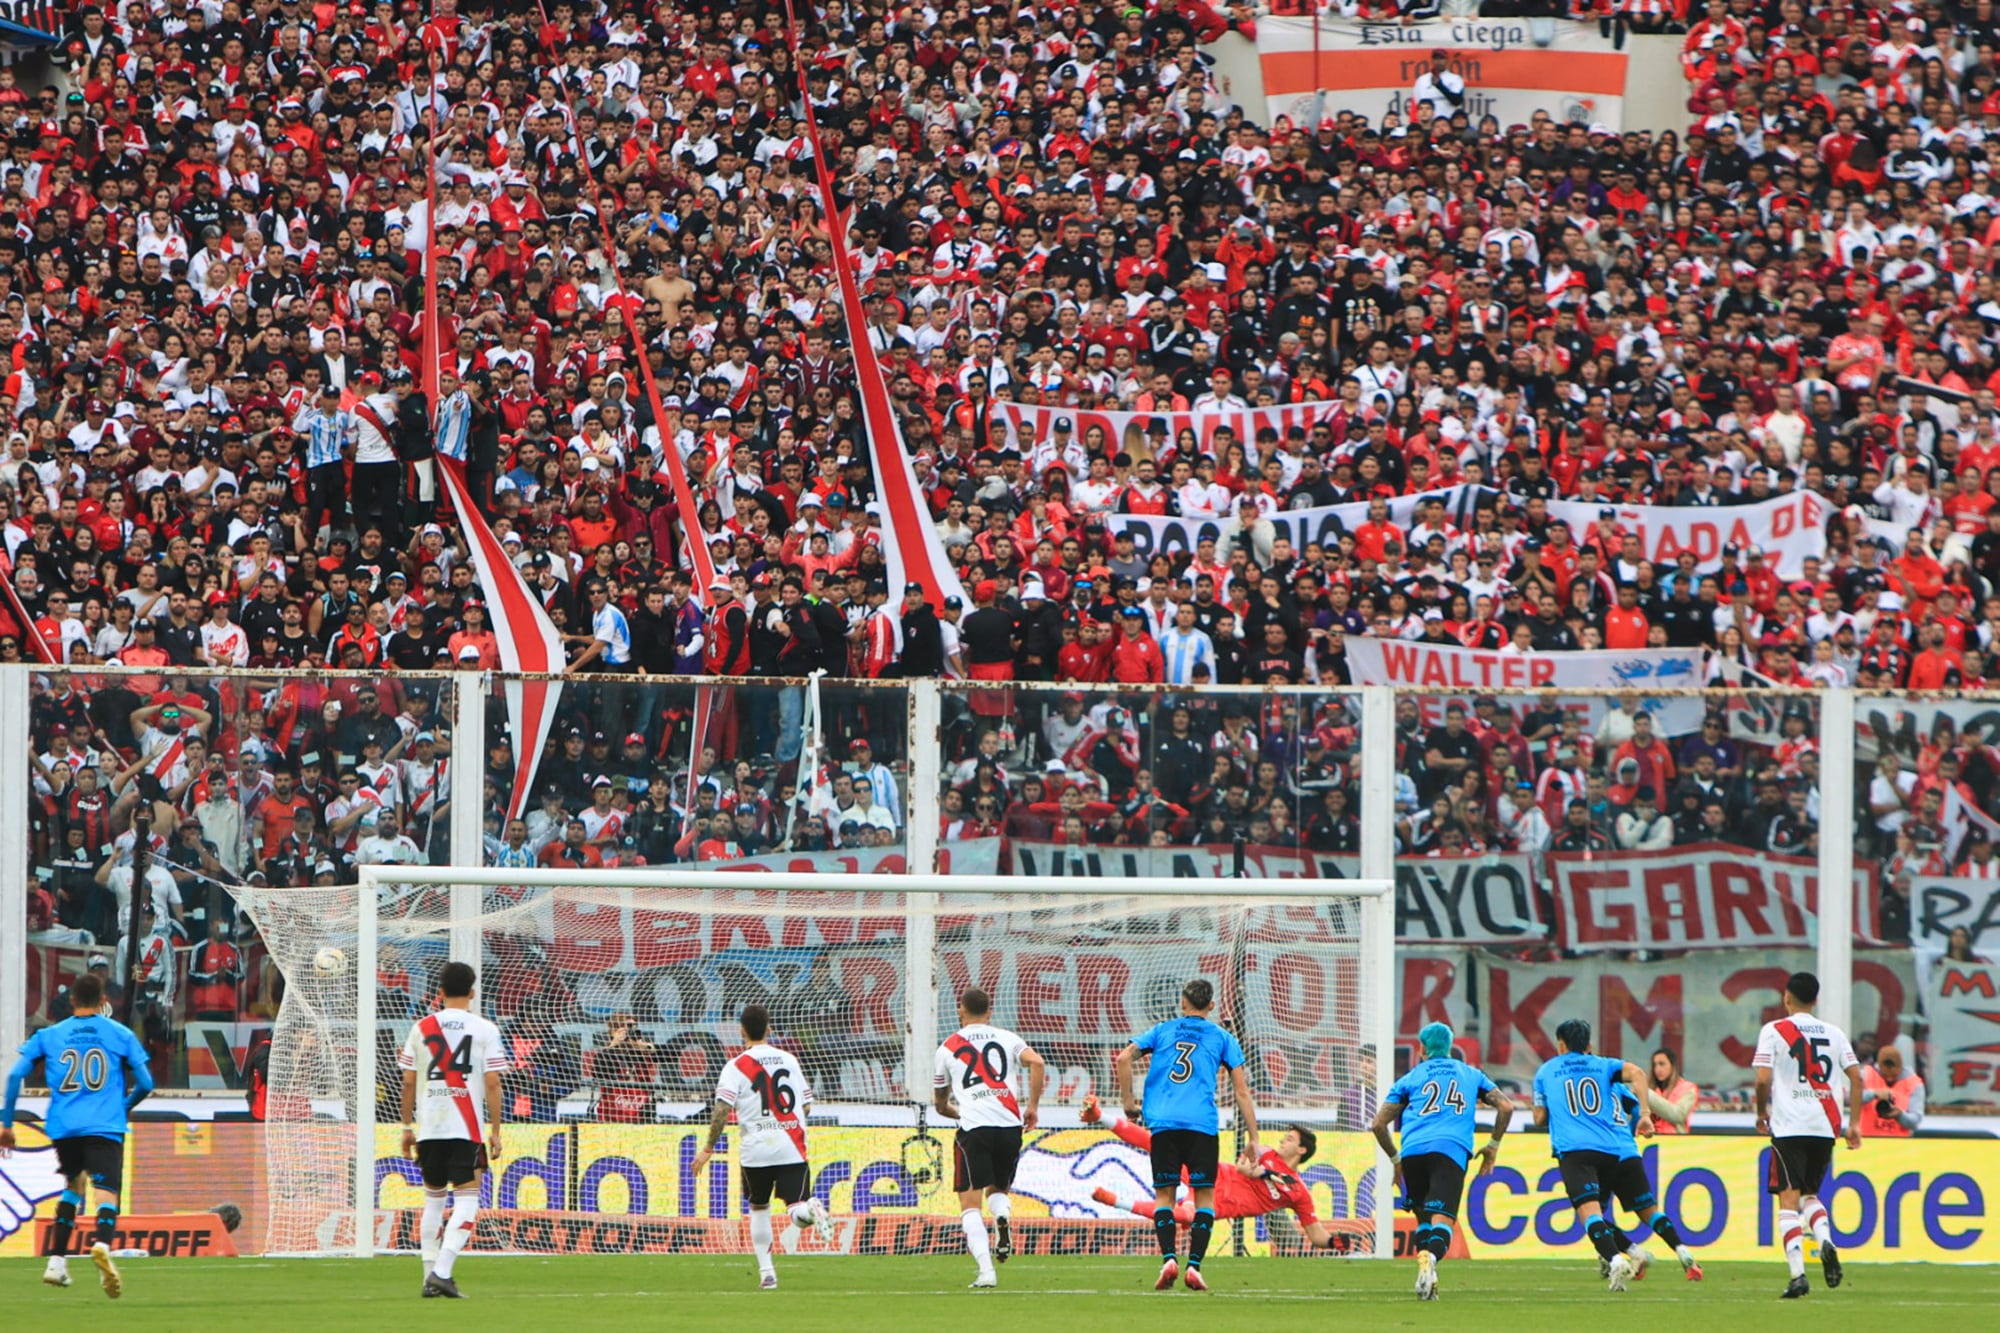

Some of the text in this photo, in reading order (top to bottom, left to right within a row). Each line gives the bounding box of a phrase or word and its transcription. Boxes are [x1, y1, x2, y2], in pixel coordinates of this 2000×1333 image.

[1452, 23, 1523, 51] ciega
[1401, 53, 1482, 82] raón
[1381, 642, 1557, 688] WALTER
[59, 1048, 108, 1093] 20
[423, 1034, 473, 1081] 24
[953, 1041, 1007, 1090] 20
[1168, 1041, 1197, 1084] 3
[1788, 1036, 1833, 1084] 15
[750, 1068, 795, 1117] 16
[1419, 1079, 1466, 1116] 24
[1565, 1076, 1602, 1117] 10
